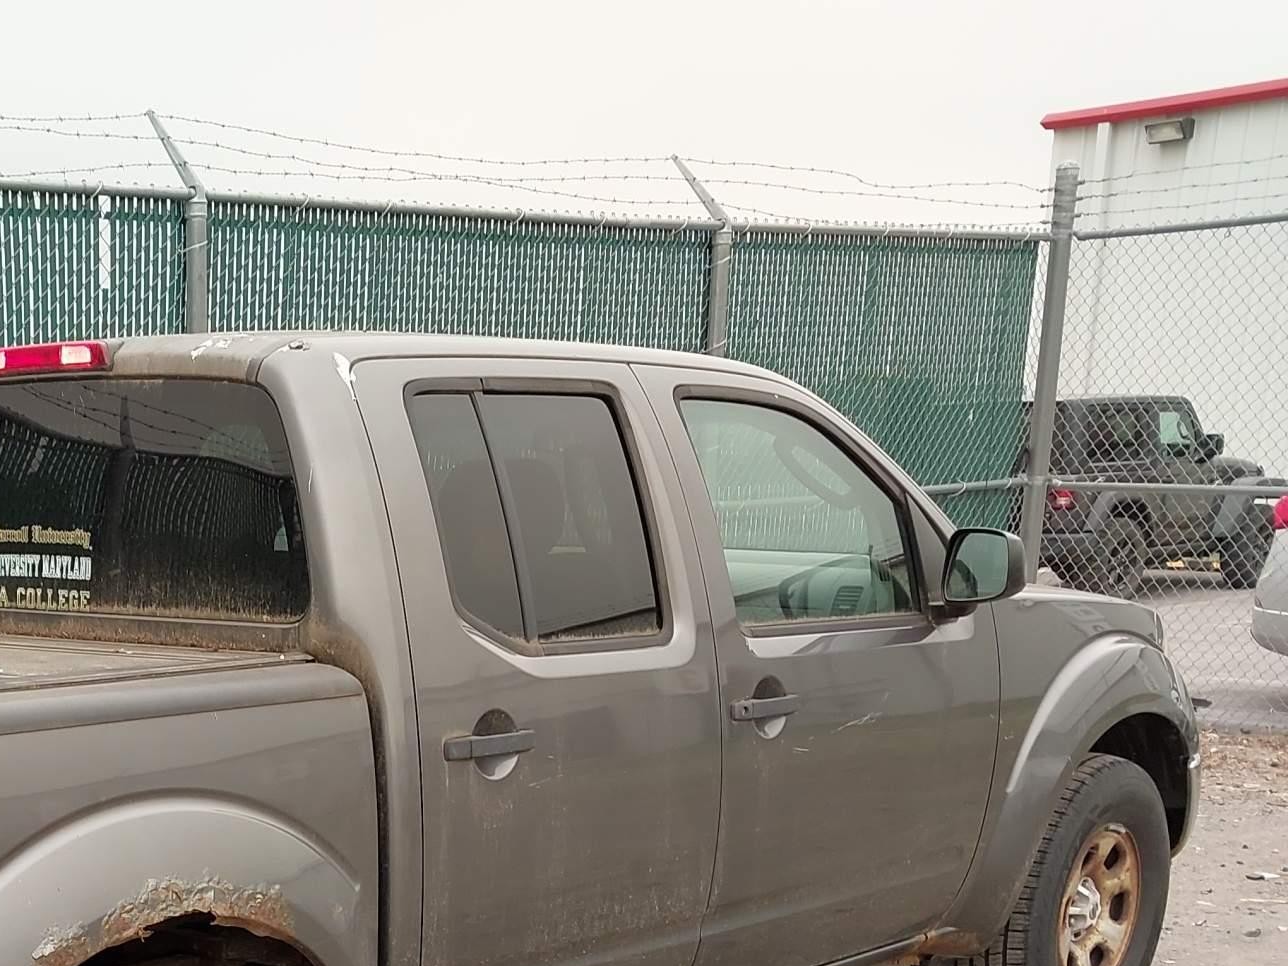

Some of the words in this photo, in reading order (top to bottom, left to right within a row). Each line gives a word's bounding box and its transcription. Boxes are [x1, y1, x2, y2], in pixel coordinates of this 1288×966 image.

[31, 524, 91, 548] University
[41, 554, 92, 581] MARYLAND
[16, 586, 91, 611] COLLEGE
